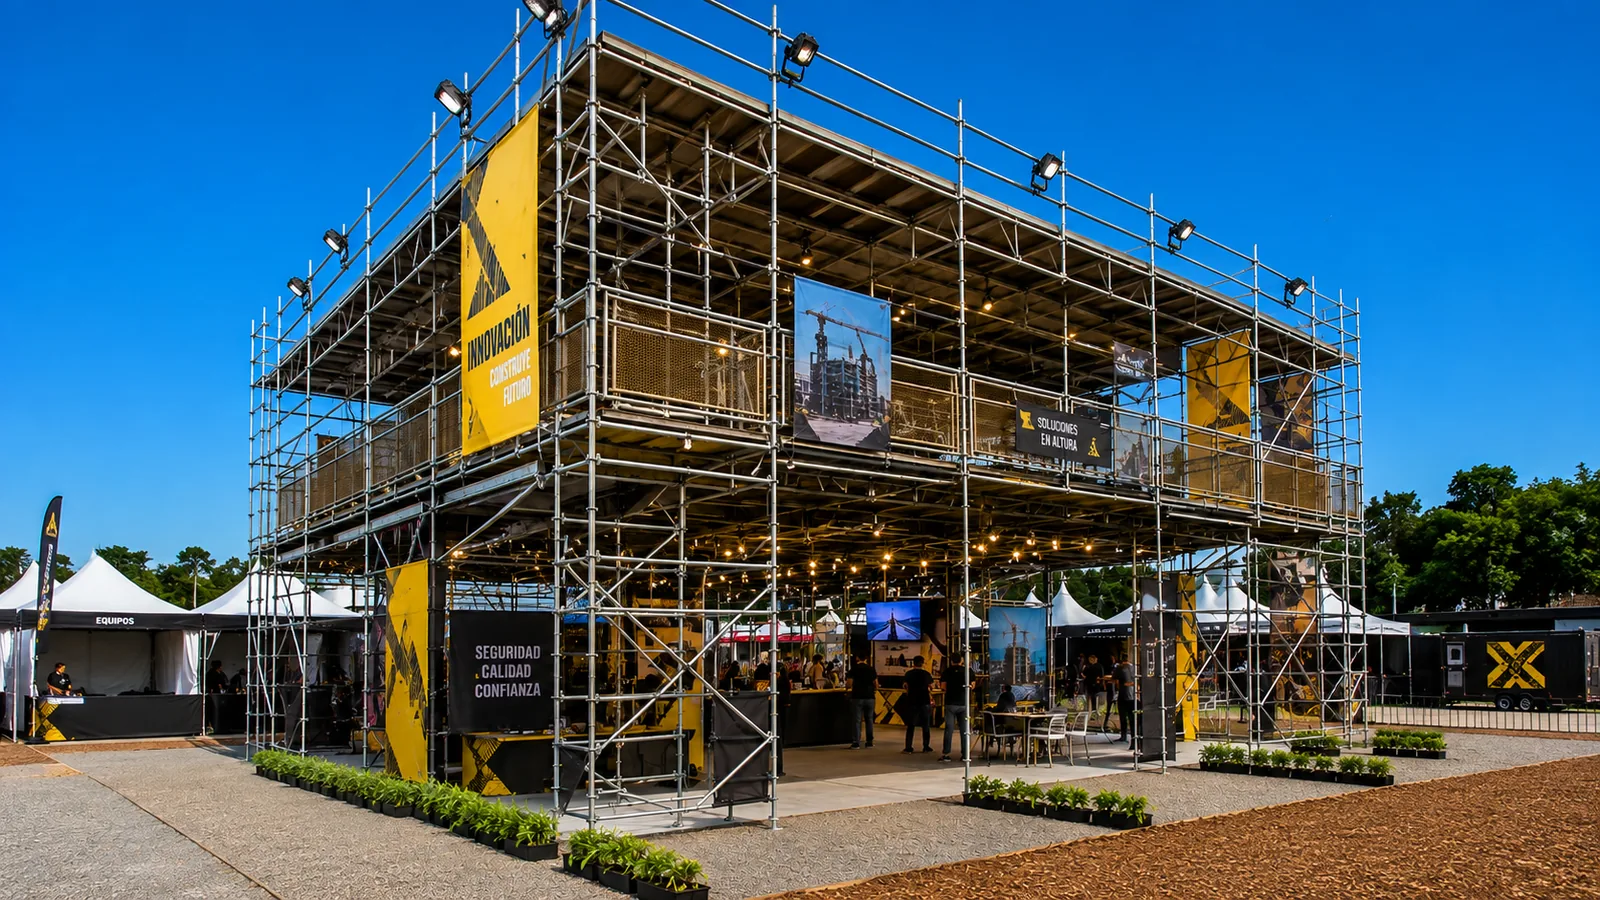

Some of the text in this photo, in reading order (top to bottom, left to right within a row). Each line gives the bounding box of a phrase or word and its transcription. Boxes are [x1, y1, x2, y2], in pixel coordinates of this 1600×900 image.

[467, 303, 530, 372] INNOVACIÓN
[503, 375, 531, 407] FUTURO
[1041, 432, 1078, 452] EN ALTURA
[95, 616, 135, 626] EQUIPOS
[475, 645, 541, 660] SEGURIDAD
[481, 664, 532, 679] CALIDAD
[474, 682, 541, 699] CONFIANZA
